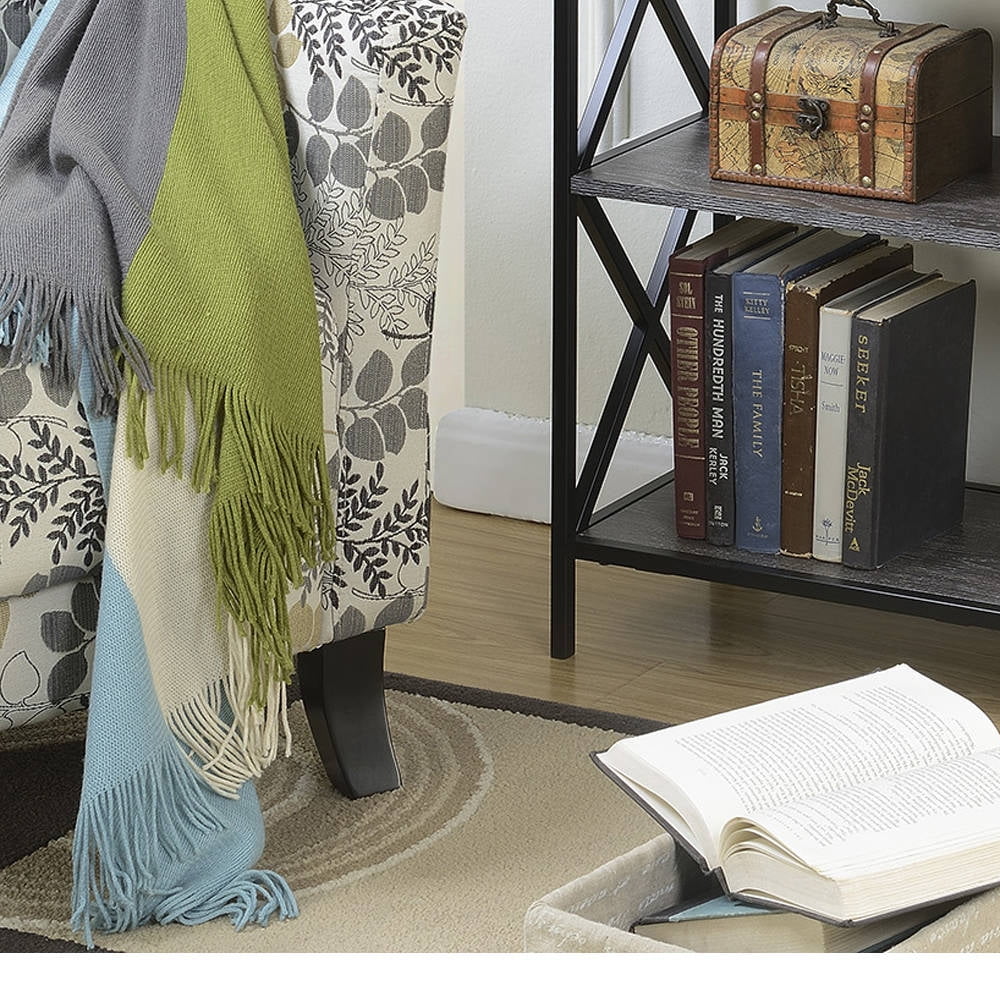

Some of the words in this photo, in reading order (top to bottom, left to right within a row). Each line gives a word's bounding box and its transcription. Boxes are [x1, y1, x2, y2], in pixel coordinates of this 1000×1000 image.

[714, 294, 724, 314] THE
[677, 326, 699, 381] OTHER
[713, 319, 725, 402] HUNDREDTH
[752, 370, 763, 398] THE
[789, 365, 806, 416] TISHA
[677, 386, 700, 449] PEOPLE
[712, 407, 724, 439] MAN
[752, 403, 763, 458] FAMILY
[708, 447, 718, 486] KERLEY
[719, 453, 729, 480] JACK
[857, 462, 871, 496] Jack
[844, 465, 860, 533] McDevitt
